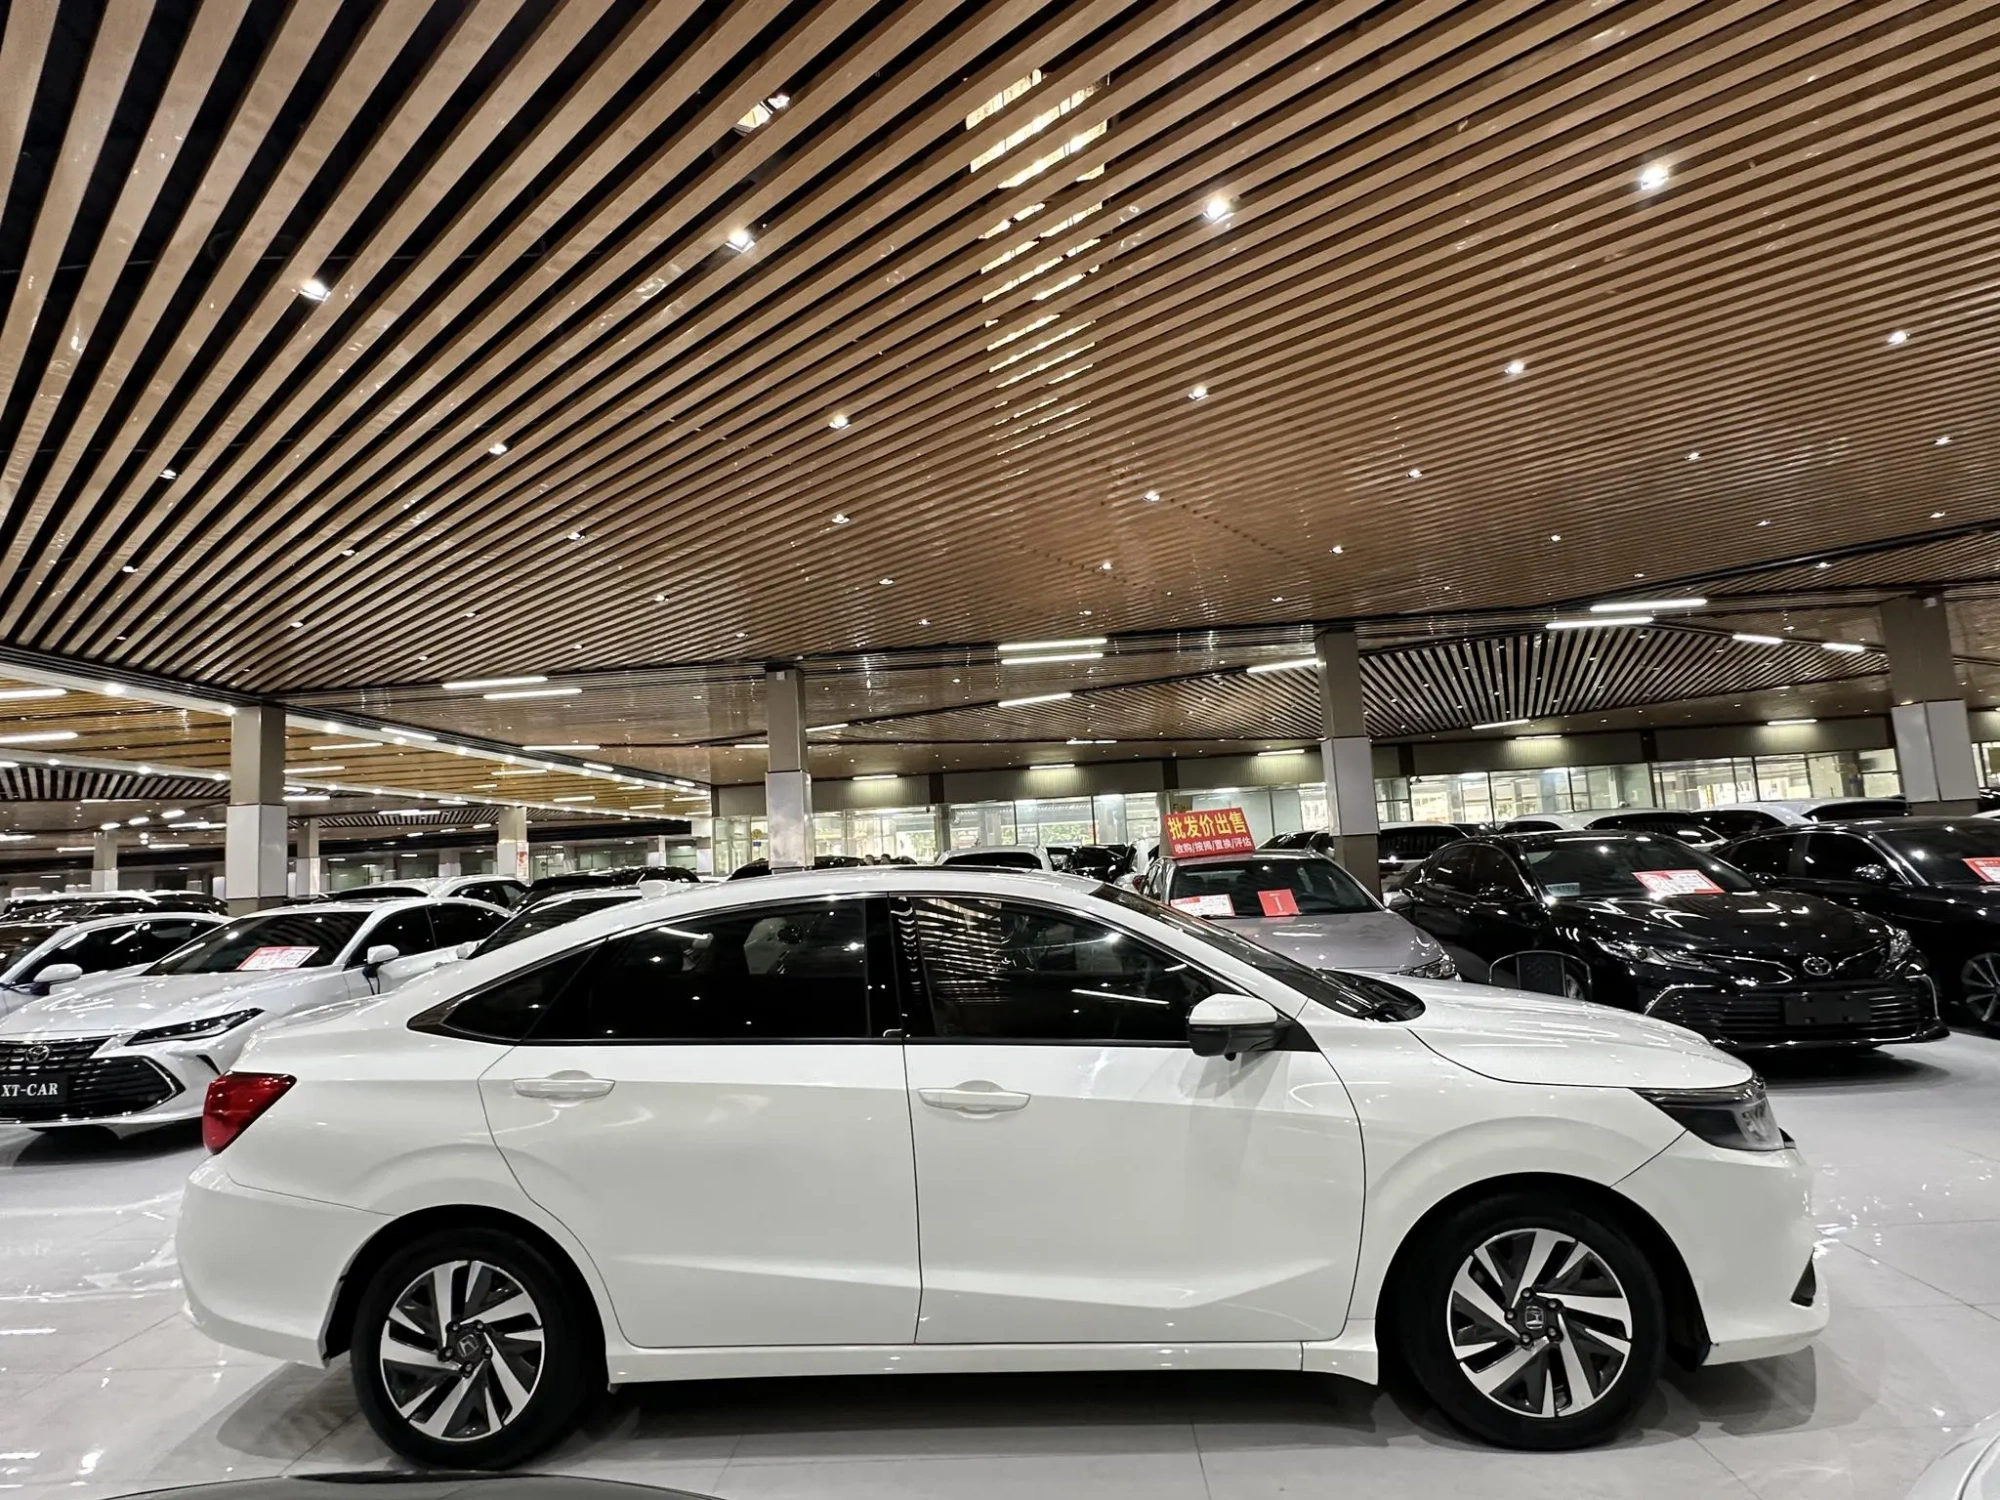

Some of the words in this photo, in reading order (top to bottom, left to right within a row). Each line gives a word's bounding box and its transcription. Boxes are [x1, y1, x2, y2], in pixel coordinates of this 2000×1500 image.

[1167, 811, 1247, 840] 批发价出售
[1, 1083, 58, 1097] XT-CAR
